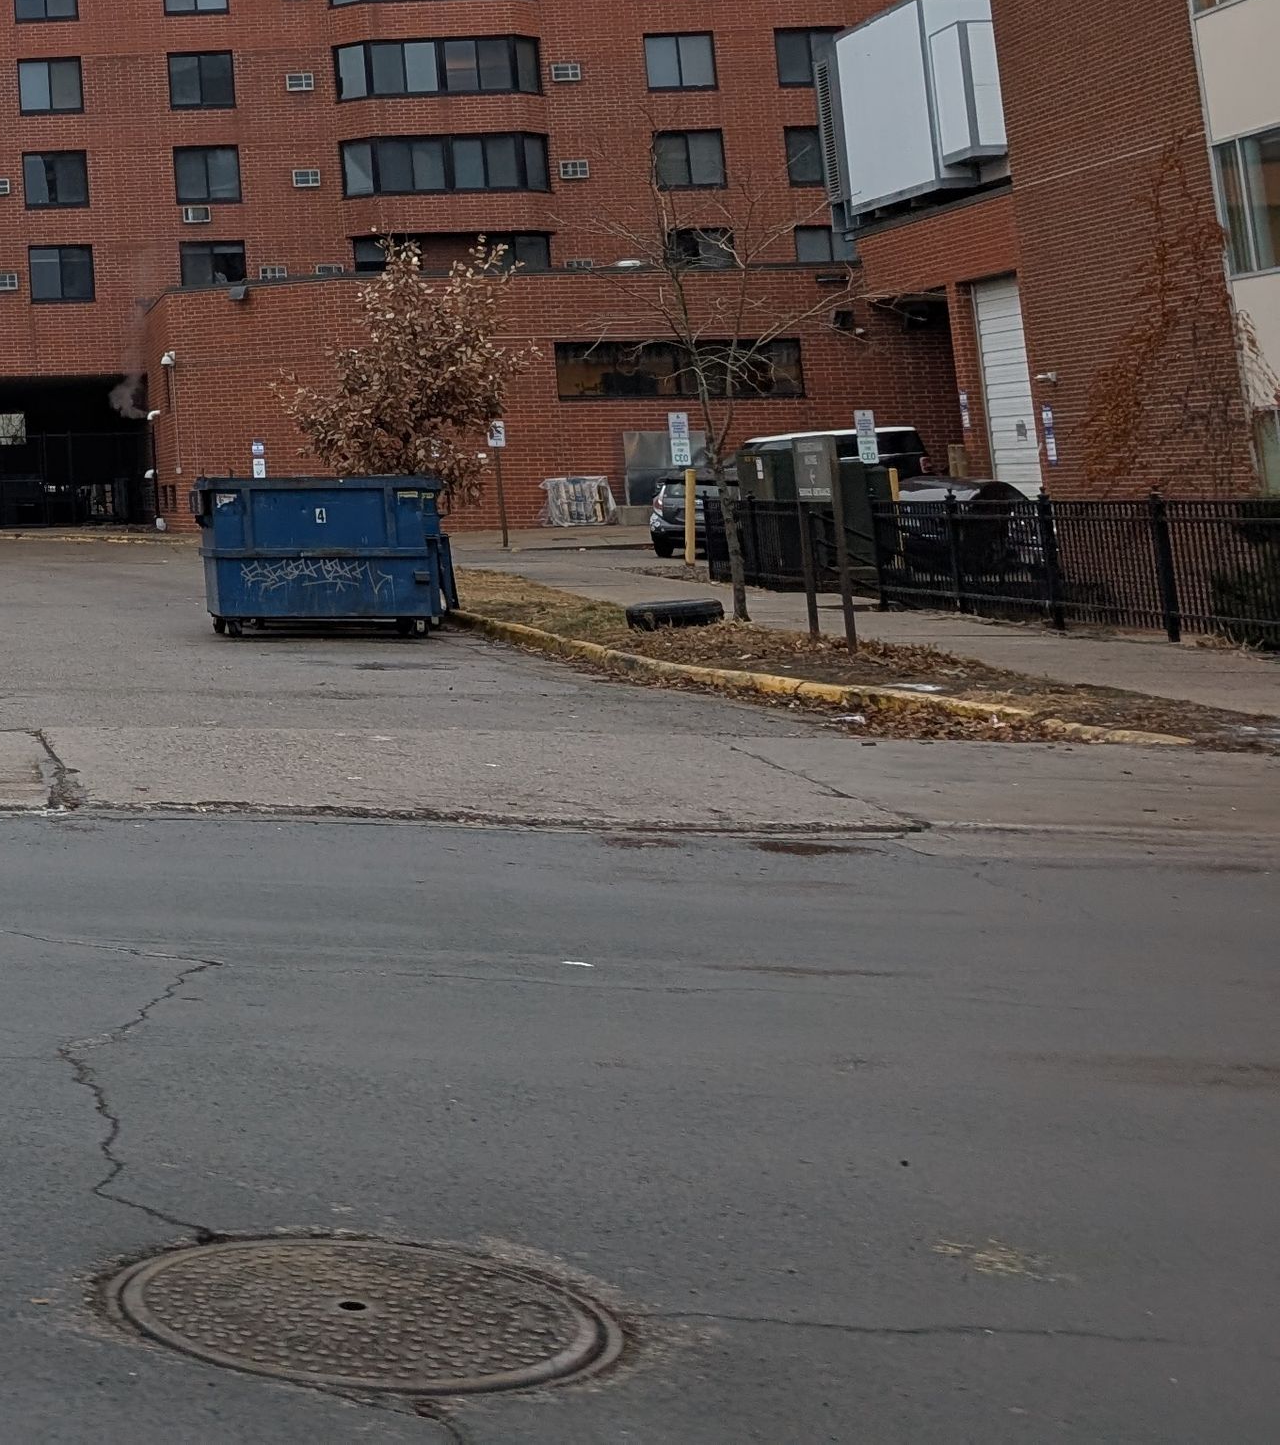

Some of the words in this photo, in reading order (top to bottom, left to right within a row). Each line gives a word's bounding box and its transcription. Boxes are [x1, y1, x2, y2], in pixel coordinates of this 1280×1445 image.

[674, 453, 689, 462] CEO
[861, 452, 876, 460] CEO
[317, 509, 325, 522] 4
